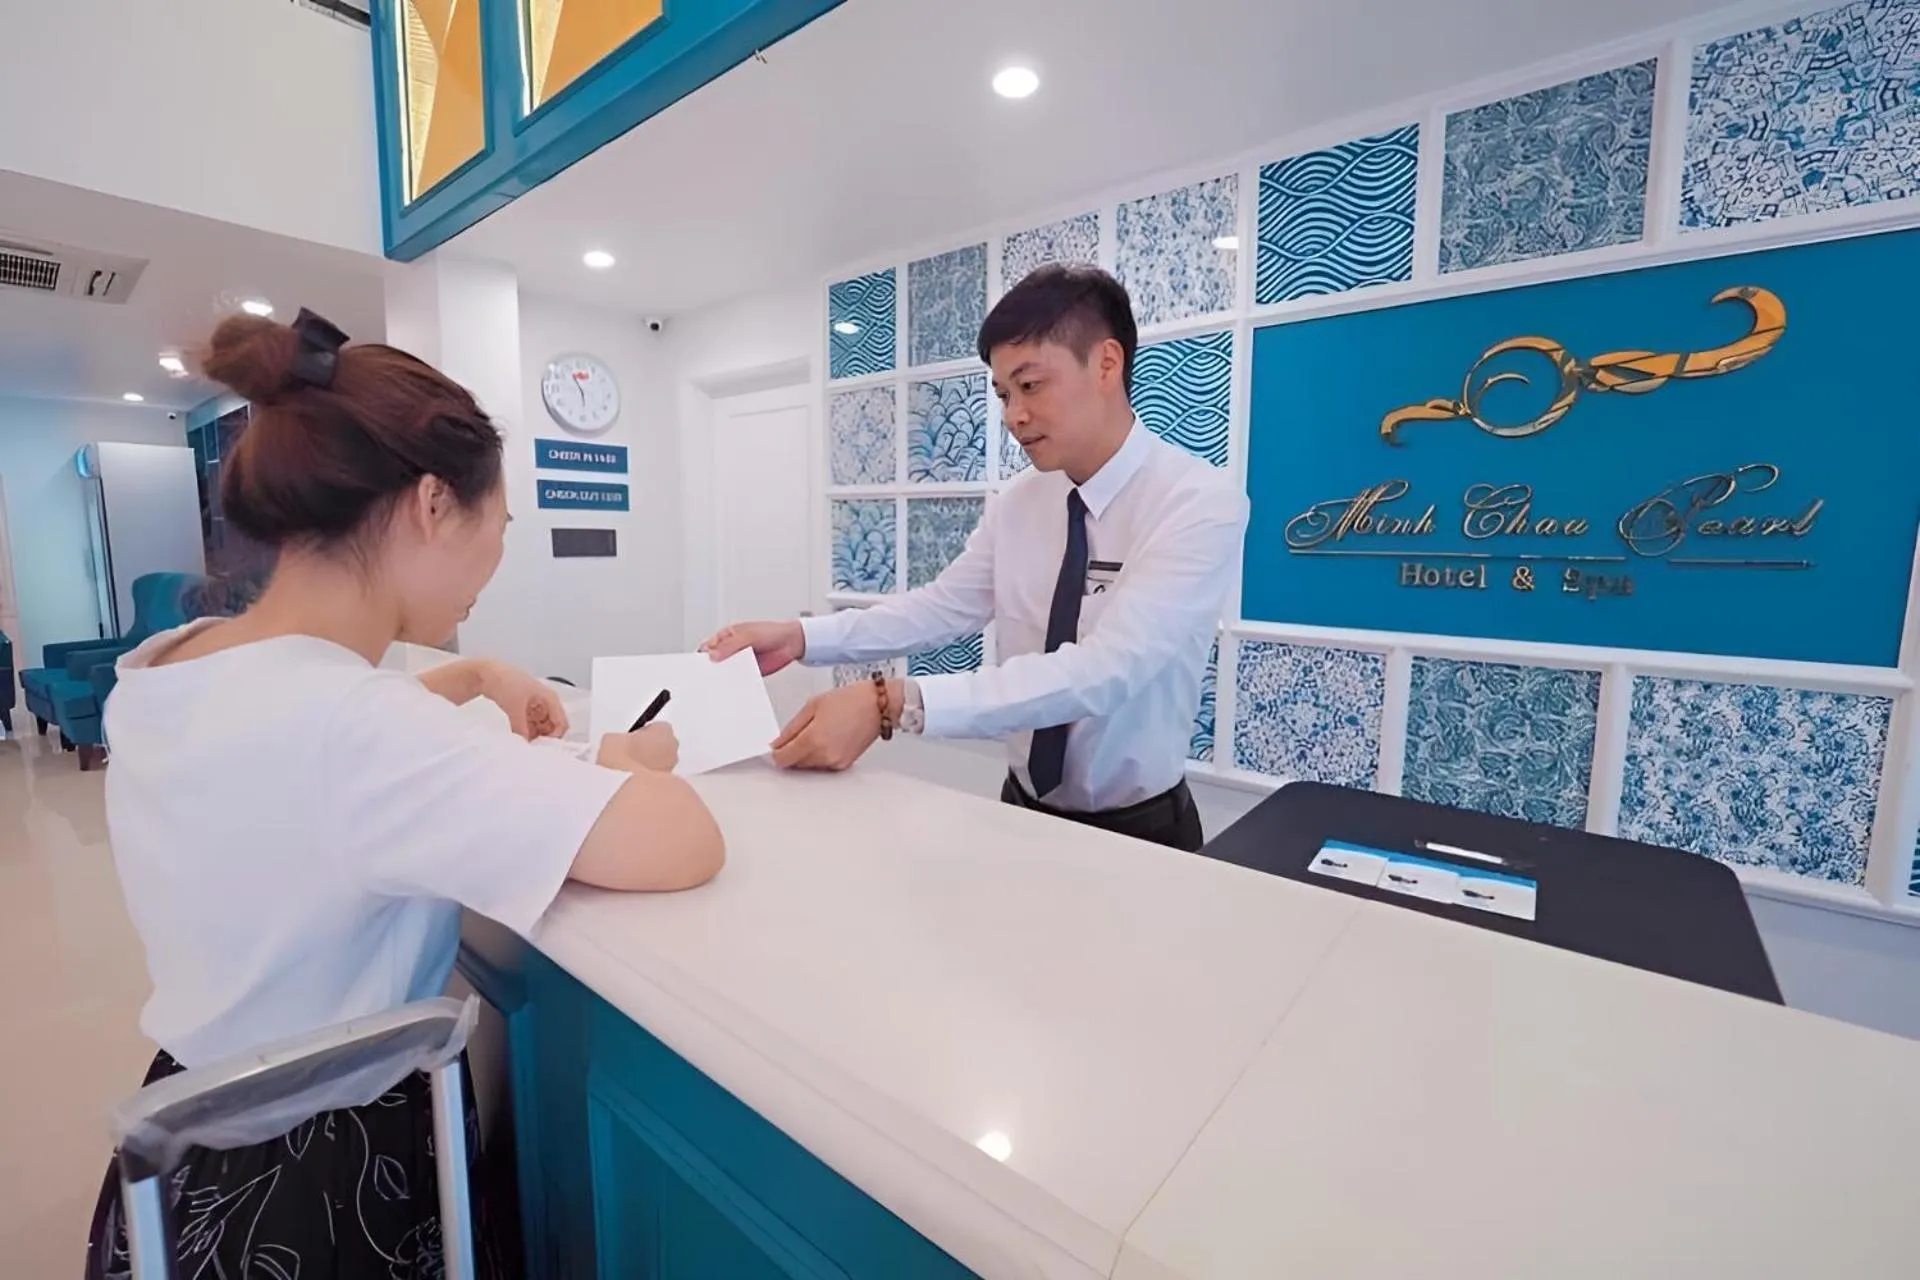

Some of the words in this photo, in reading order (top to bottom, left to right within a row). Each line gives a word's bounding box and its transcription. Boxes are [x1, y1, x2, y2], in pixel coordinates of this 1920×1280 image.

[1284, 479, 1436, 548] Minh
[1463, 483, 1588, 539] Chau
[1618, 463, 1824, 557] Pearl
[1400, 562, 1488, 588] Hotel
[1511, 566, 1535, 590] &
